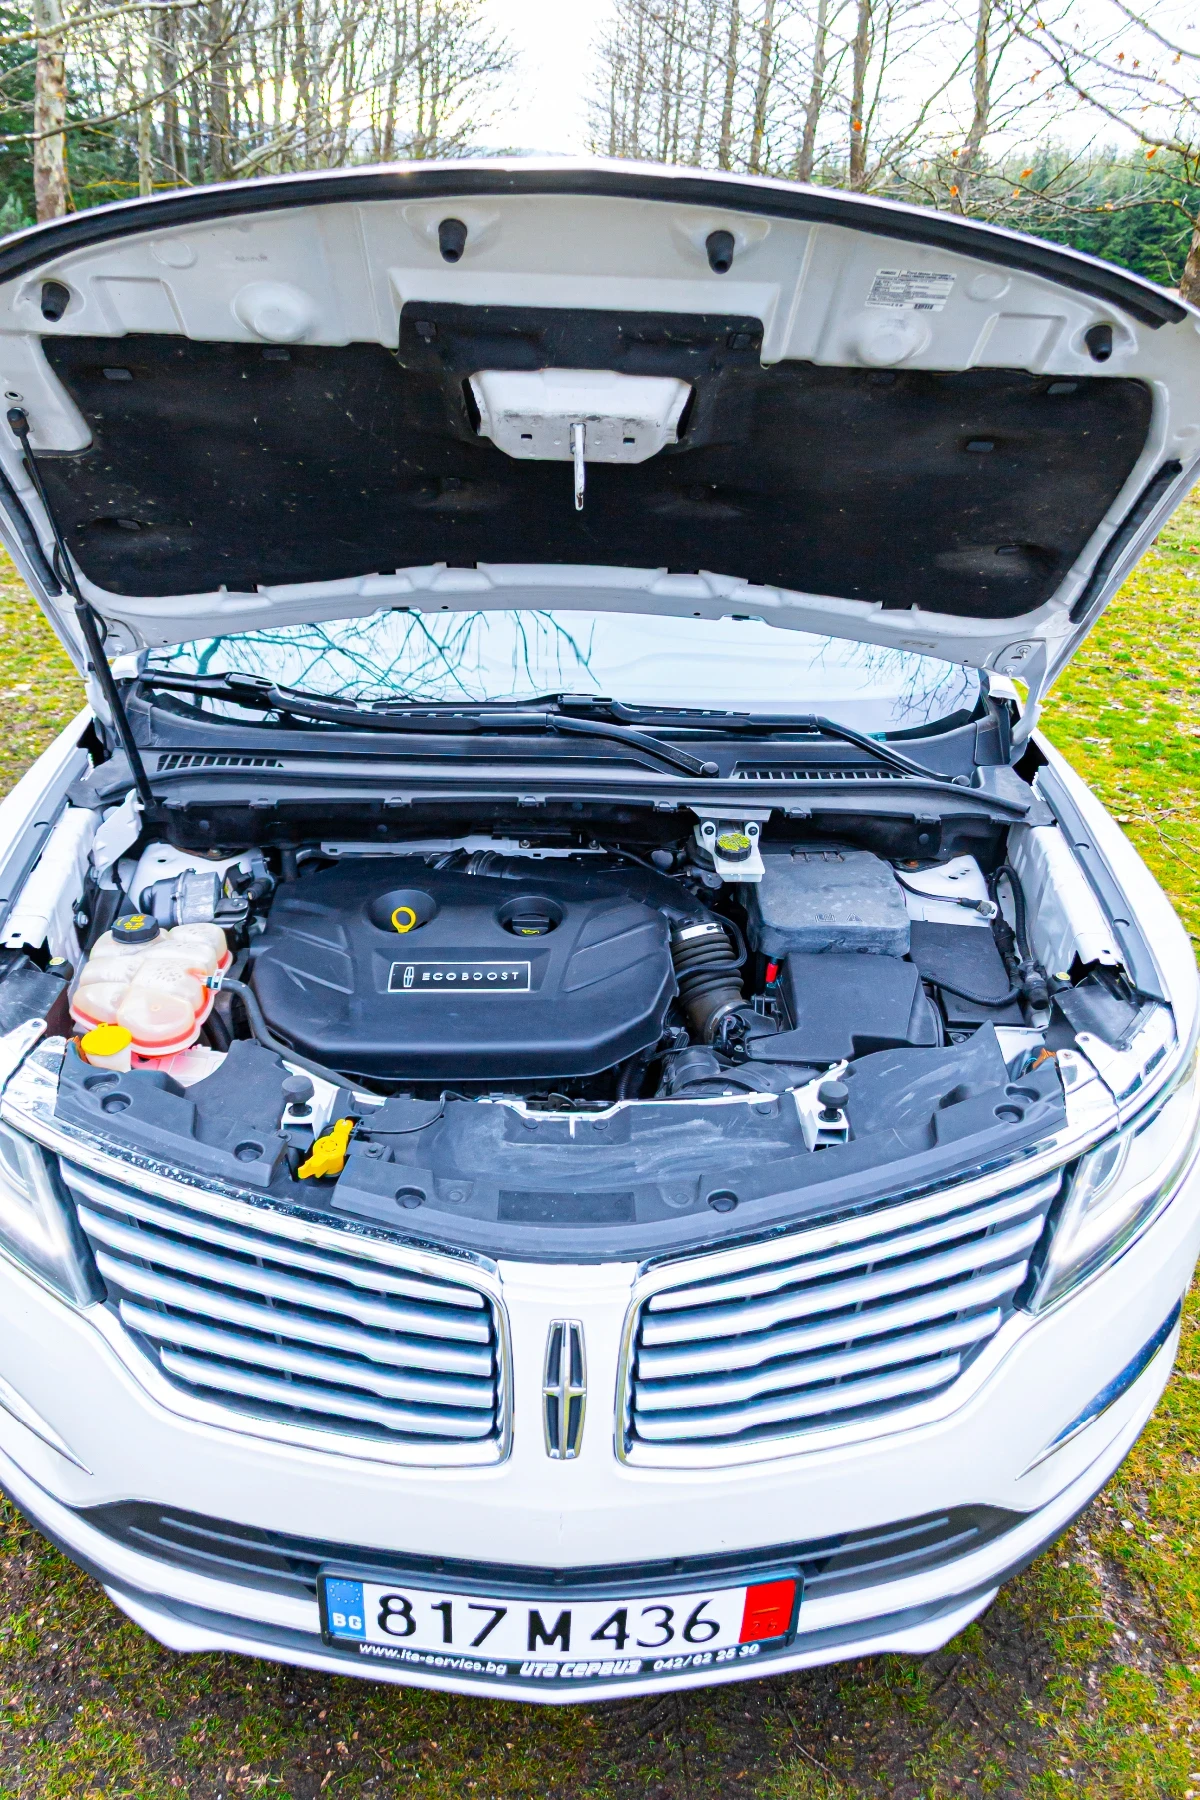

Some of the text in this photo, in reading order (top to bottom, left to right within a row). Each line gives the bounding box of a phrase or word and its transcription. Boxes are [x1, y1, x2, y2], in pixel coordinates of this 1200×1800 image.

[421, 971, 519, 981] ECOBOOST
[332, 1612, 362, 1630] BG
[377, 1592, 721, 1652] 817 M 436
[359, 1643, 508, 1678] www.ita-service.bg
[653, 1643, 760, 1672] 042/62 25 30
